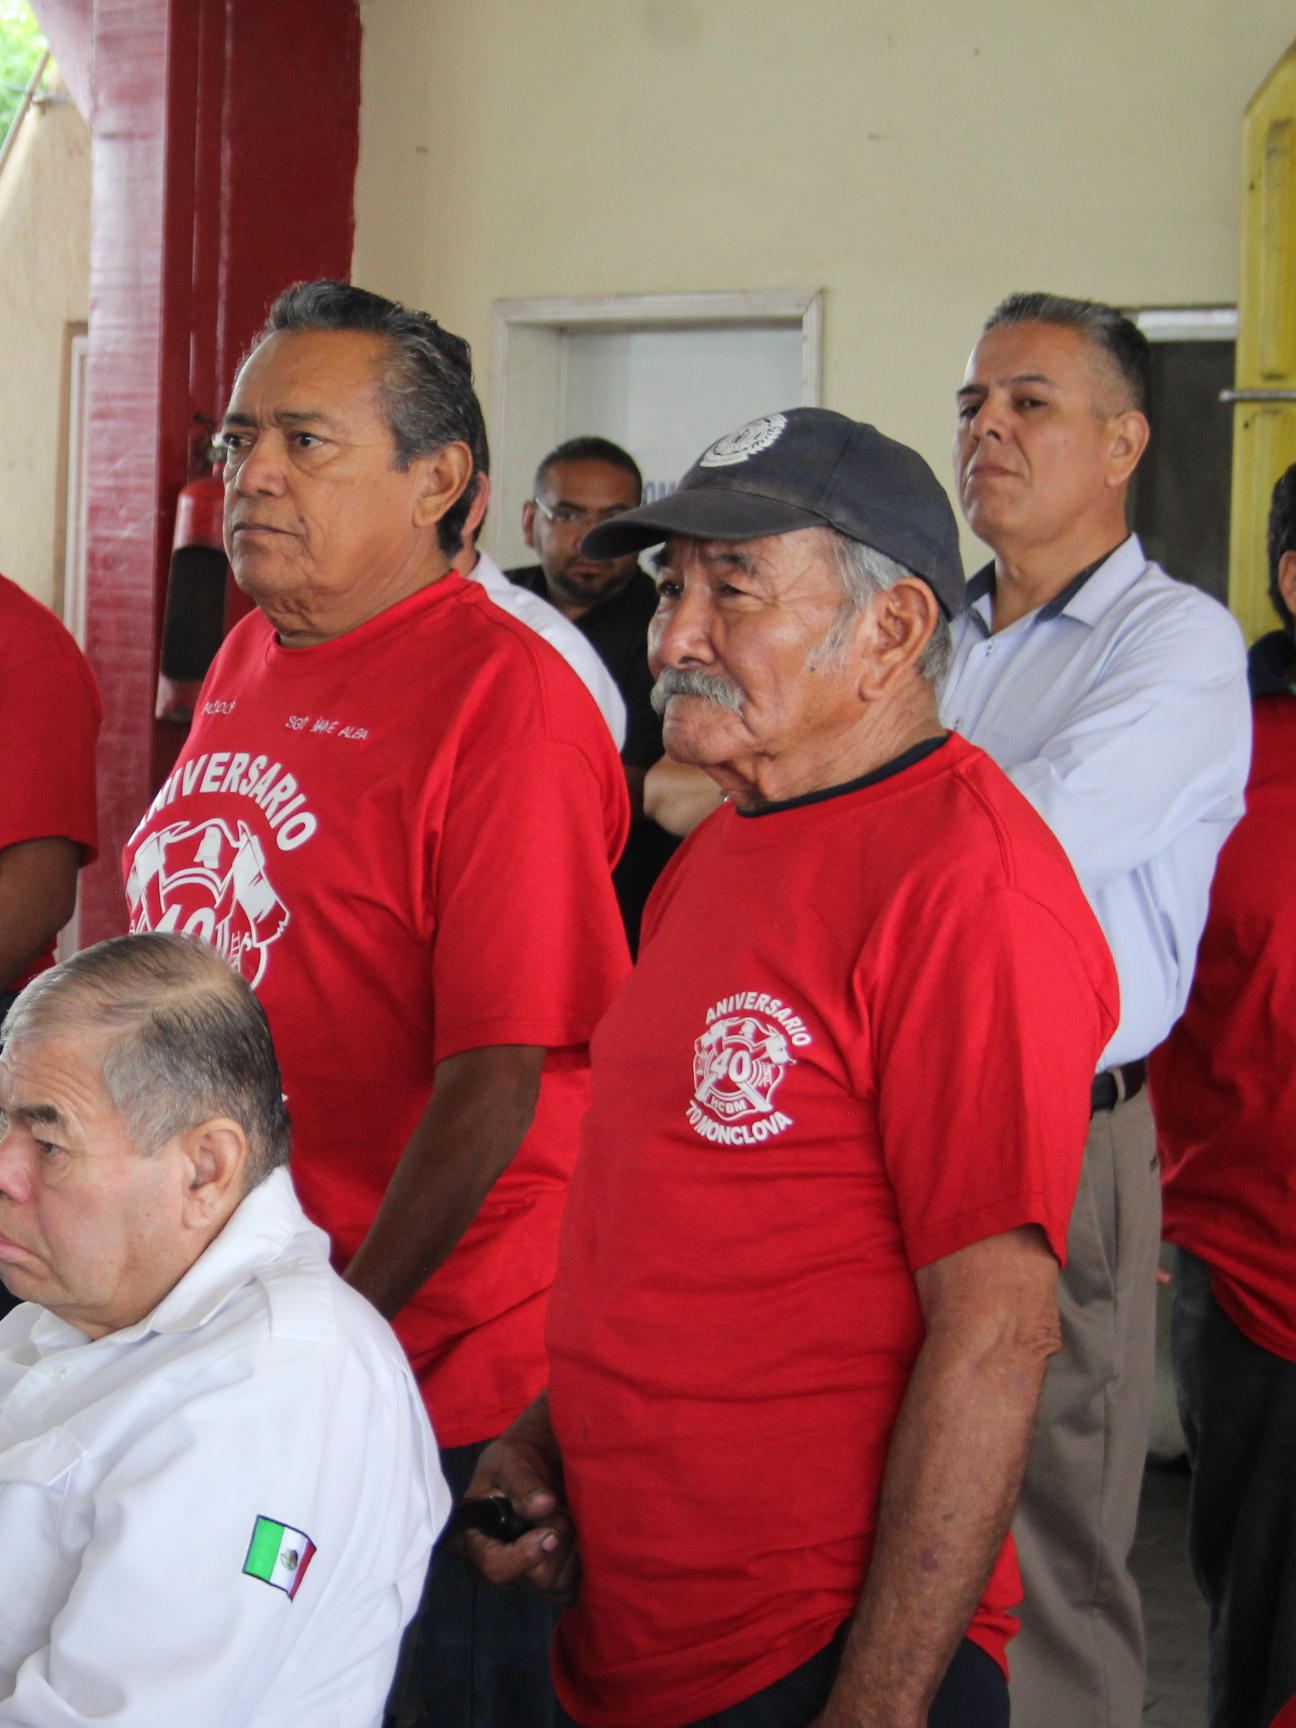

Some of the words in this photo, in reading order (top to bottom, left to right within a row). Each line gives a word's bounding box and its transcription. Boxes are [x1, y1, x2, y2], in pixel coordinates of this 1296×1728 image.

[706, 991, 812, 1047] ANIVERSARIO
[710, 1047, 751, 1083] 40
[710, 1095, 747, 1114] HCBM
[693, 1110, 793, 1146] MONCLOVA
